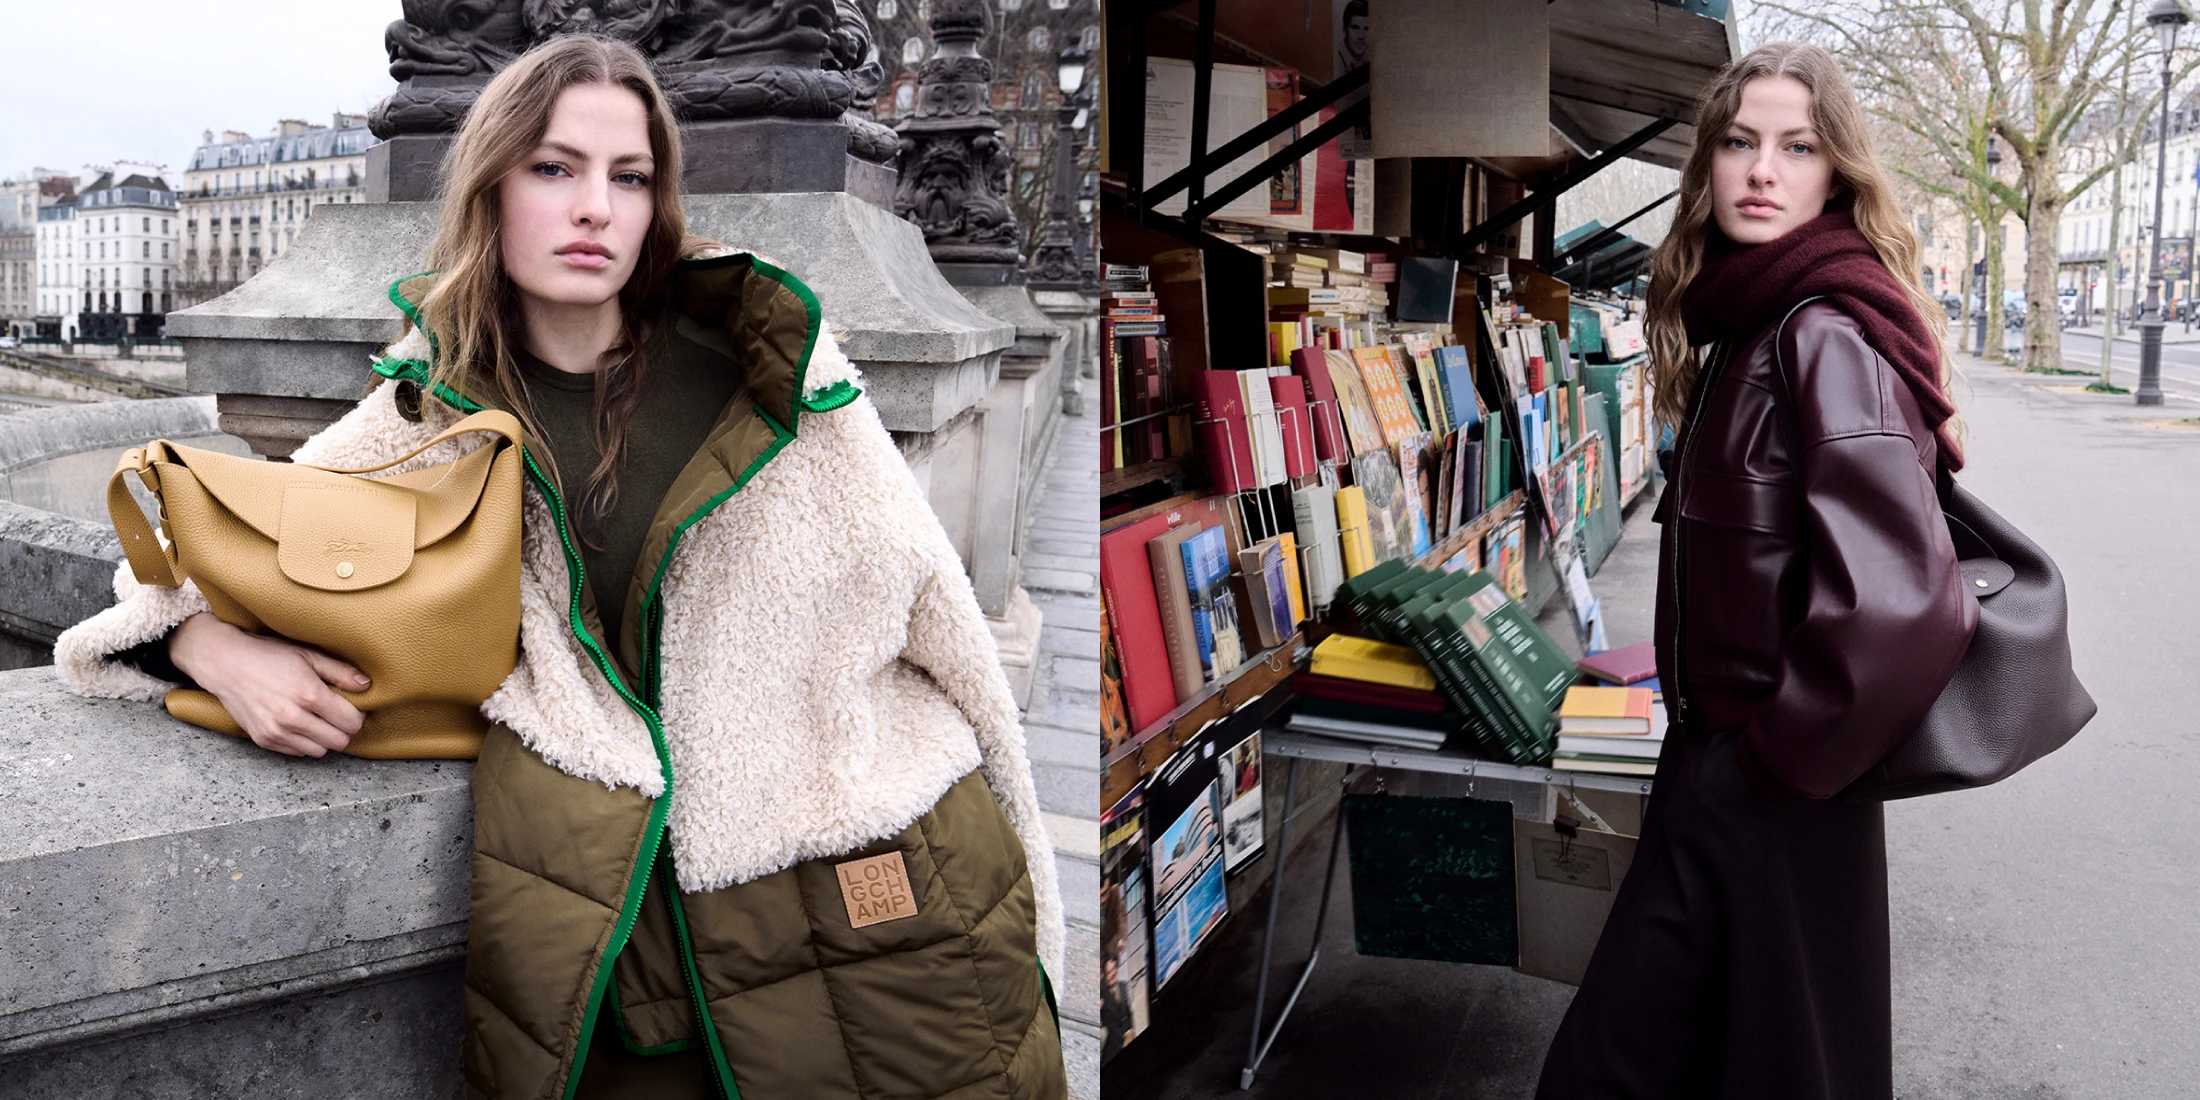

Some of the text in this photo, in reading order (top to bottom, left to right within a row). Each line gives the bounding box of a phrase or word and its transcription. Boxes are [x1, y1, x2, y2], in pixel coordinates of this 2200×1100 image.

[843, 859, 900, 886] LON
[849, 876, 905, 903] GCH
[857, 894, 907, 920] AMP
